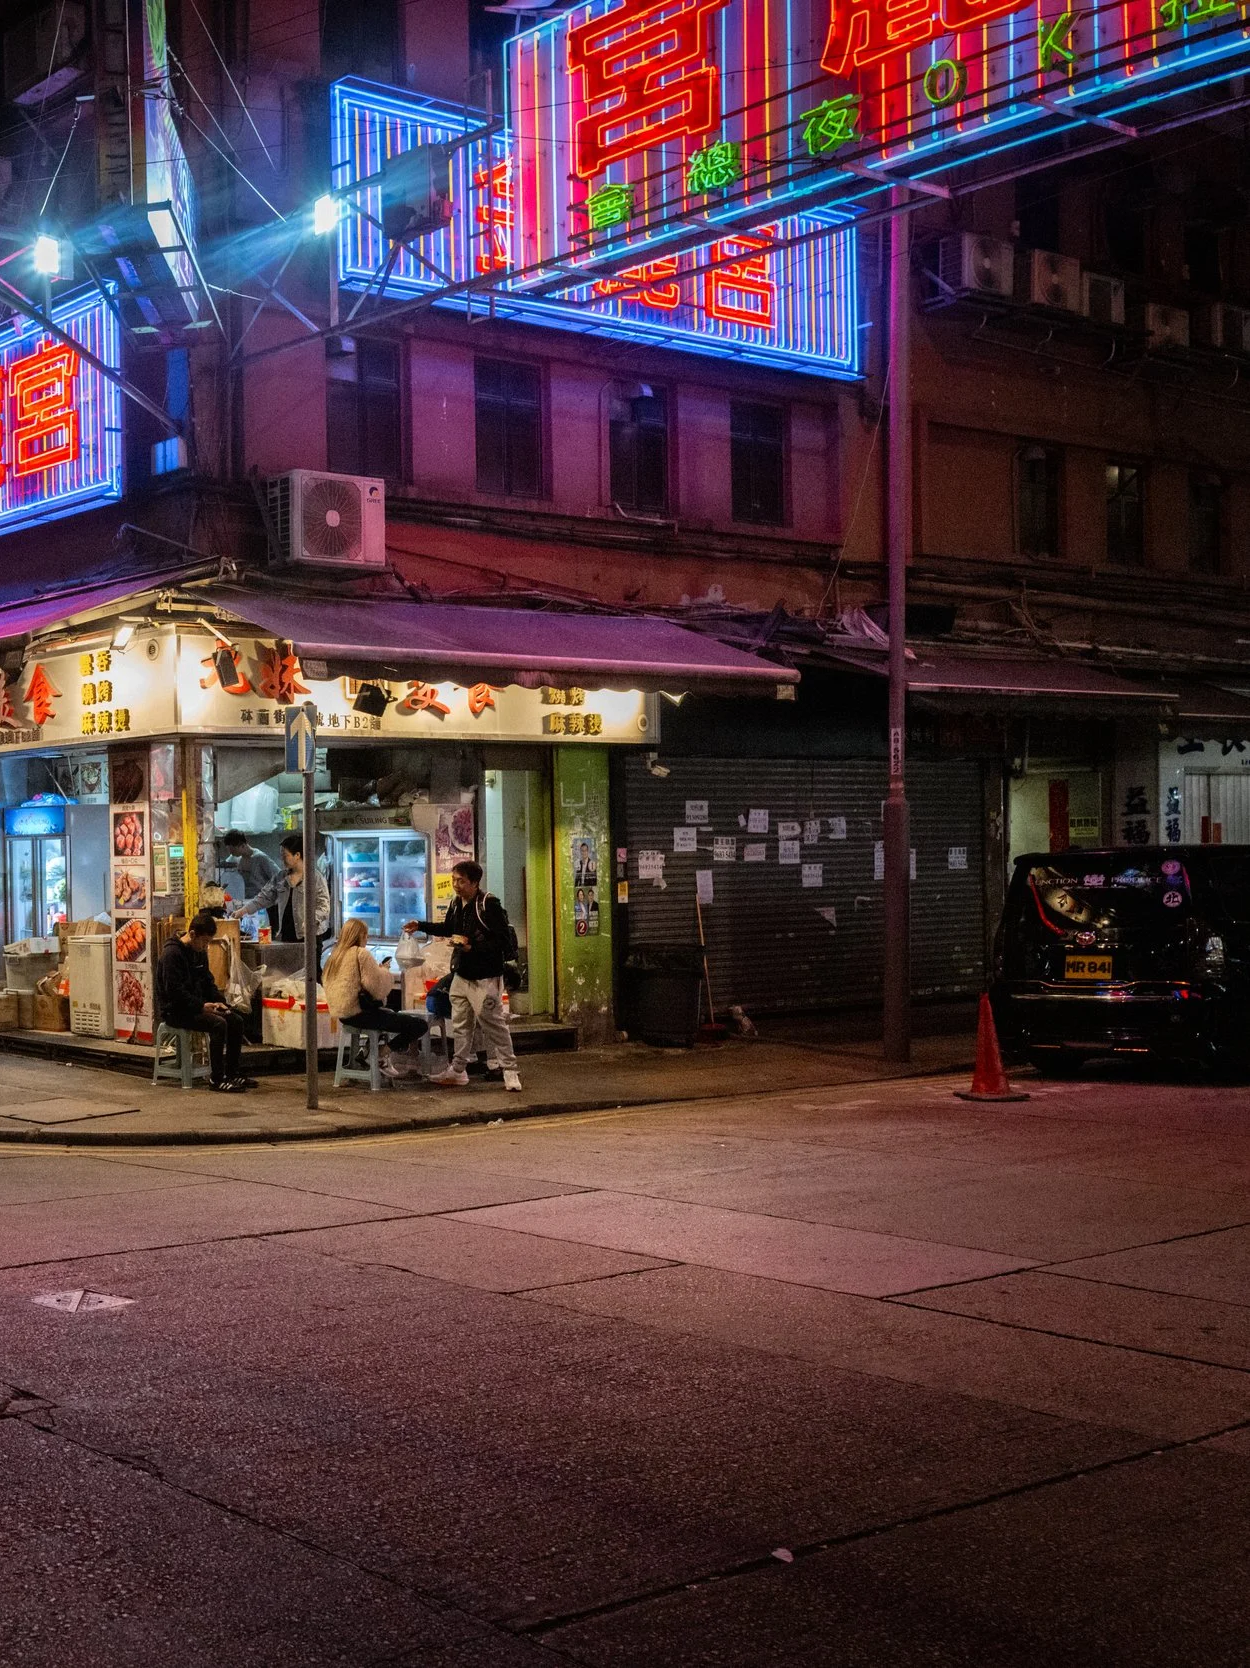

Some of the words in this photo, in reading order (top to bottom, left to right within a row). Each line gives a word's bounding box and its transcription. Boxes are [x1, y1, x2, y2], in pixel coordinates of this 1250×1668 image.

[579, 922, 585, 933] 2
[1066, 961, 1086, 974] MR
[1087, 961, 1111, 974] 841
